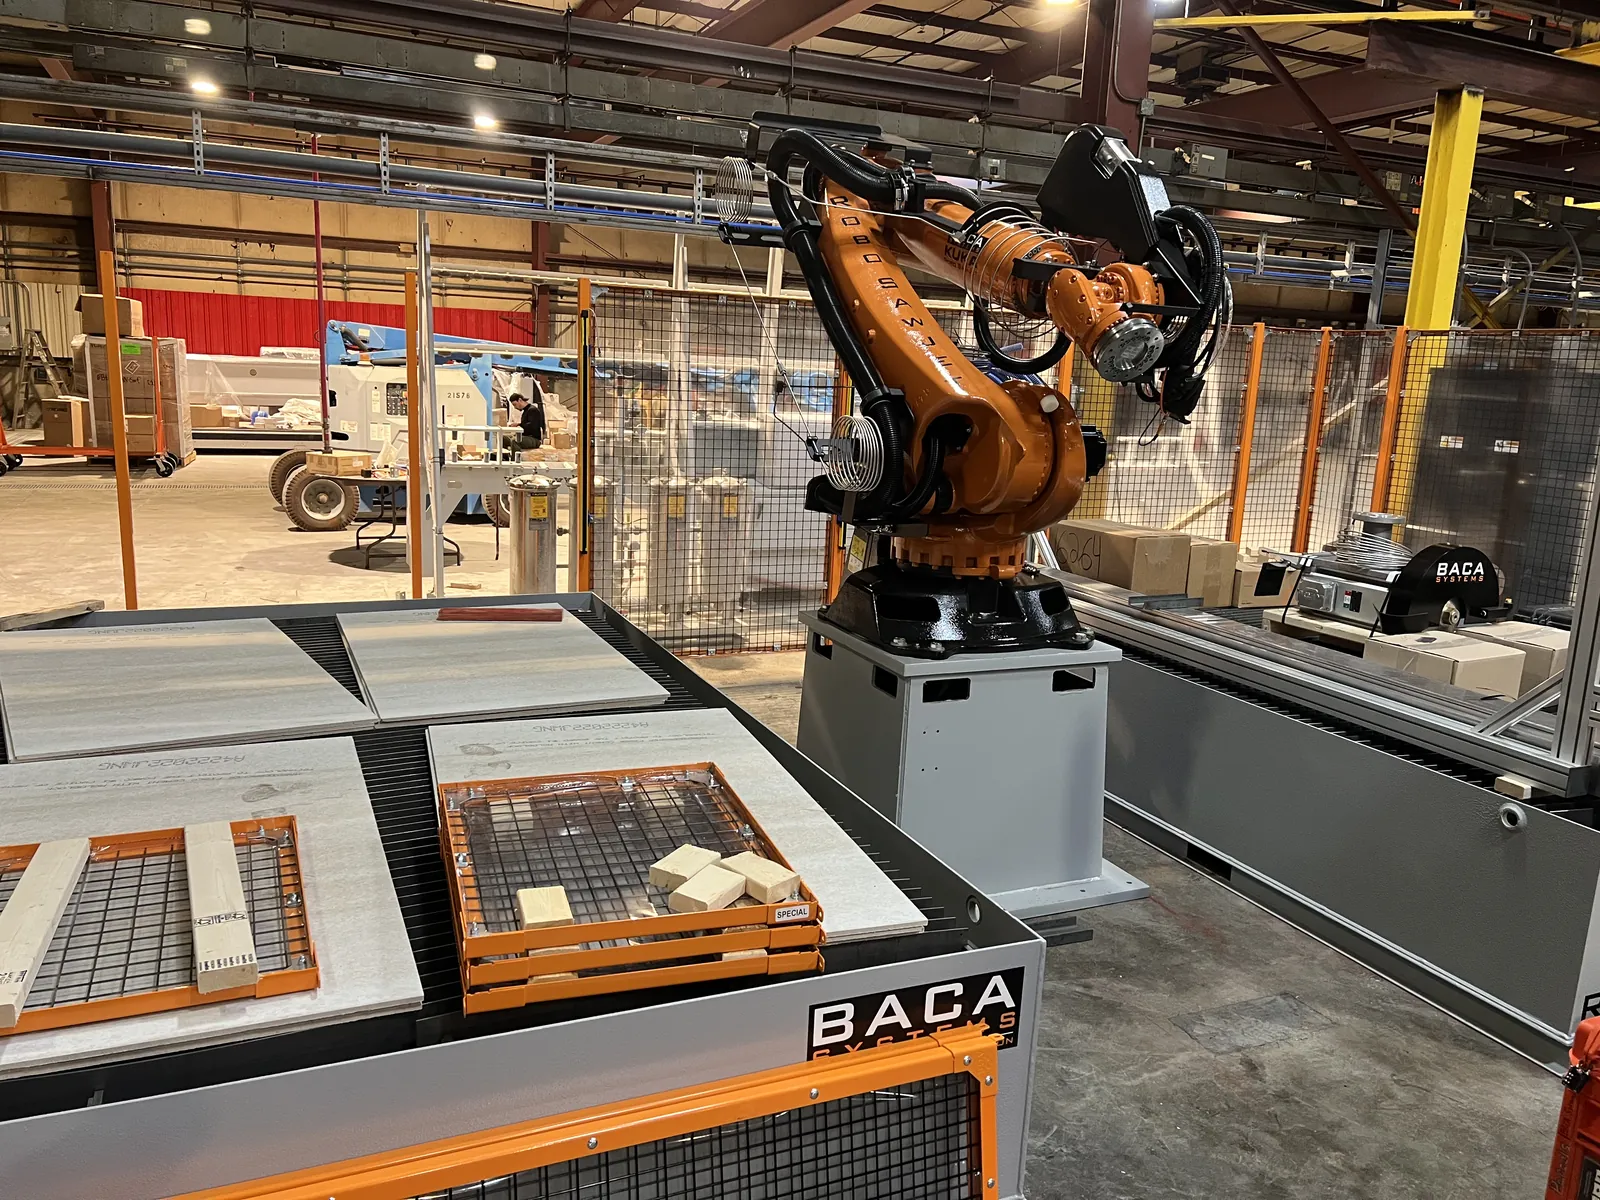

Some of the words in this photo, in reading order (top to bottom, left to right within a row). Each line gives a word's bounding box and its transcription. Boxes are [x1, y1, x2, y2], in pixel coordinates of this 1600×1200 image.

[830, 196, 882, 263] ROBO
[945, 245, 978, 268] KUKA
[1436, 562, 1485, 576] BACA
[1435, 575, 1484, 583] SYSTEMS
[777, 908, 808, 919] SPECIAL
[813, 975, 1016, 1047] BACA
